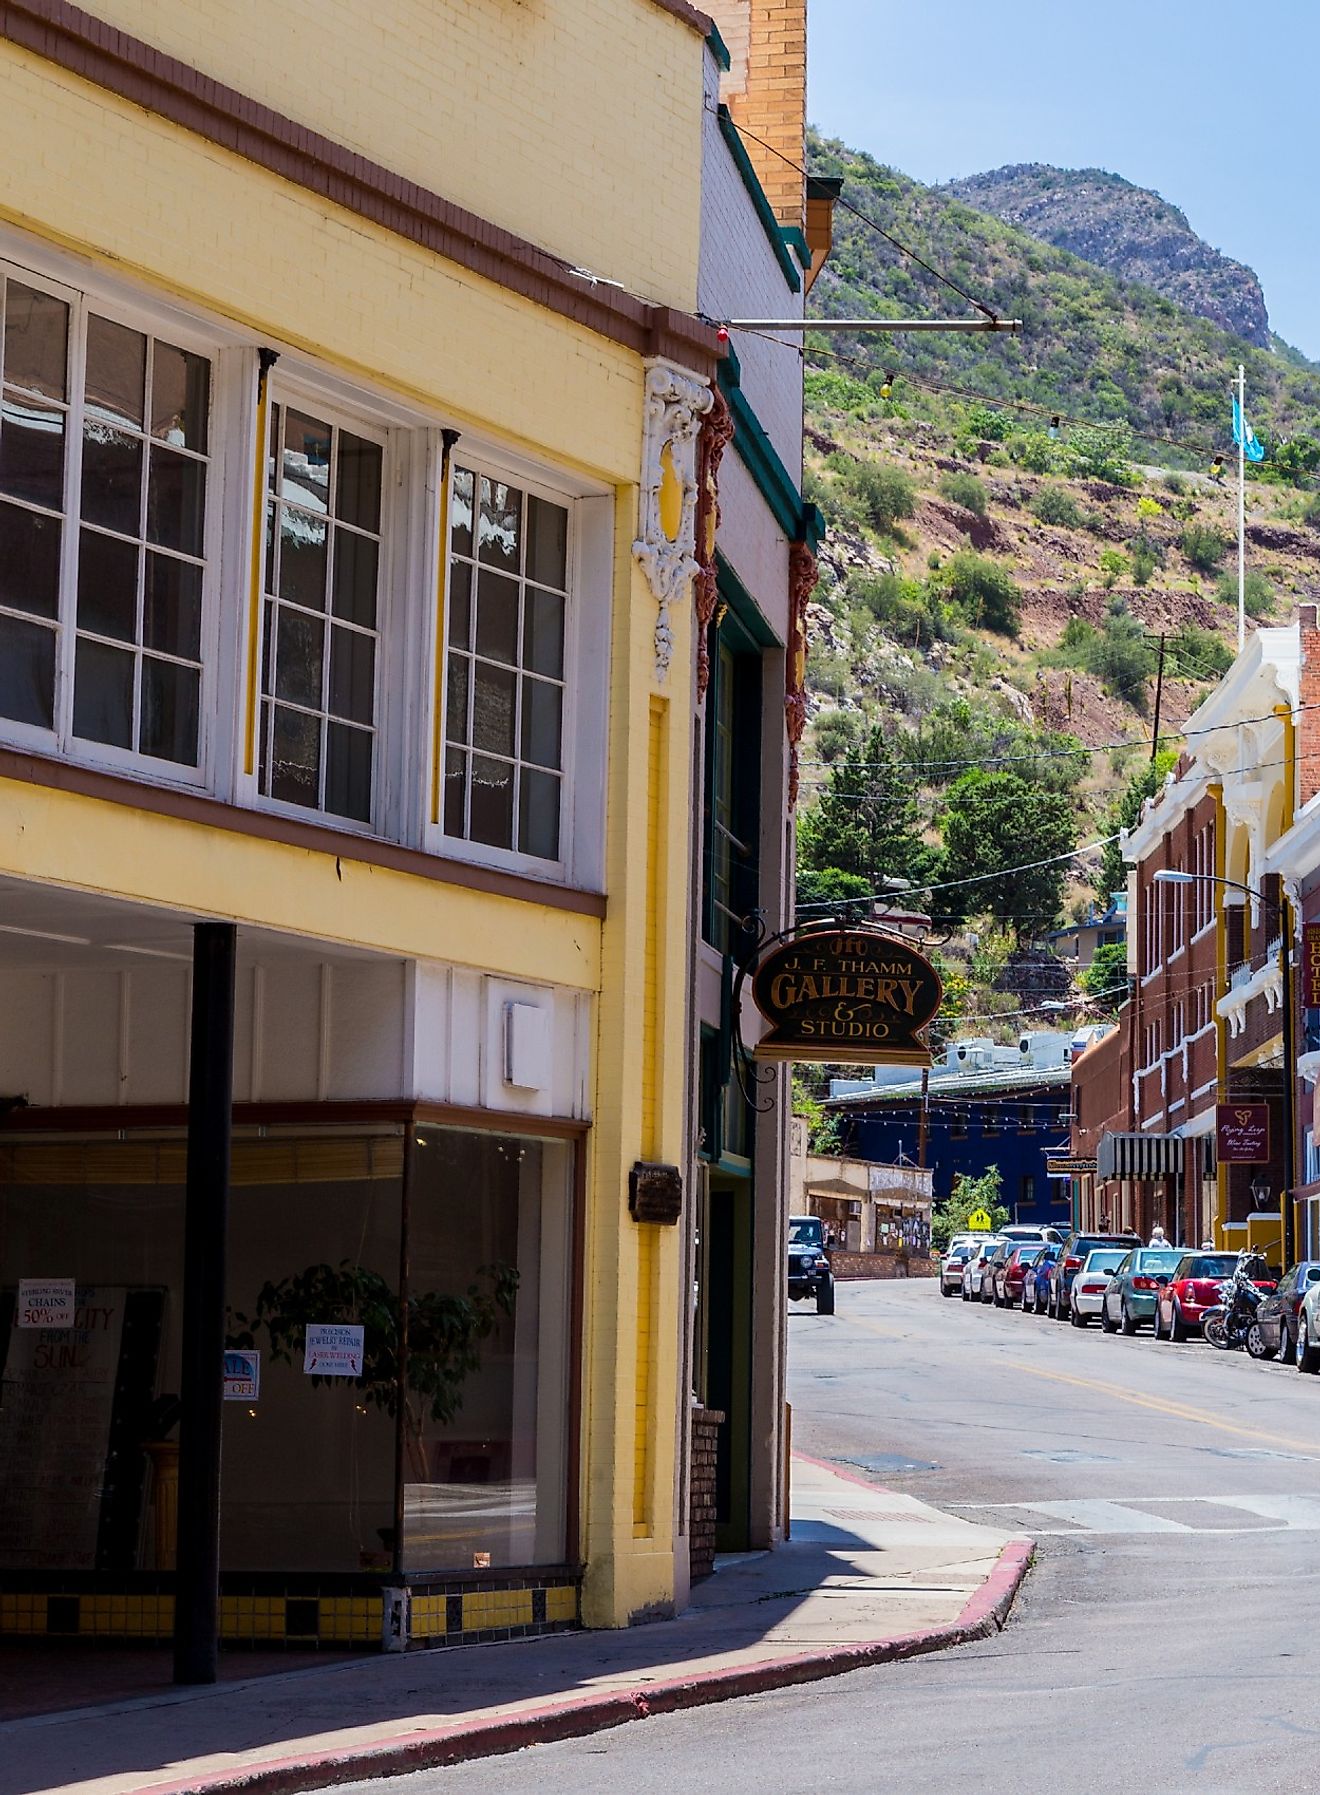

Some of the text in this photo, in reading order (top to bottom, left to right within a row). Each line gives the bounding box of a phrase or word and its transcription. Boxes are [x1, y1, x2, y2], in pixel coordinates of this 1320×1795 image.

[784, 958, 912, 975] J. F. THAMM
[771, 973, 924, 1016] GALLERY
[834, 1001, 872, 1021] &
[801, 1020, 889, 1038] STUDIO
[28, 1297, 66, 1307] CHAINS
[24, 1309, 54, 1324] 50%
[74, 1307, 115, 1330] CITY
[40, 1329, 90, 1344] FROM THE
[310, 1336, 361, 1347] JEWELRY REPAIR
[34, 1344, 80, 1369] SUN
[232, 1383, 255, 1394] OFF
